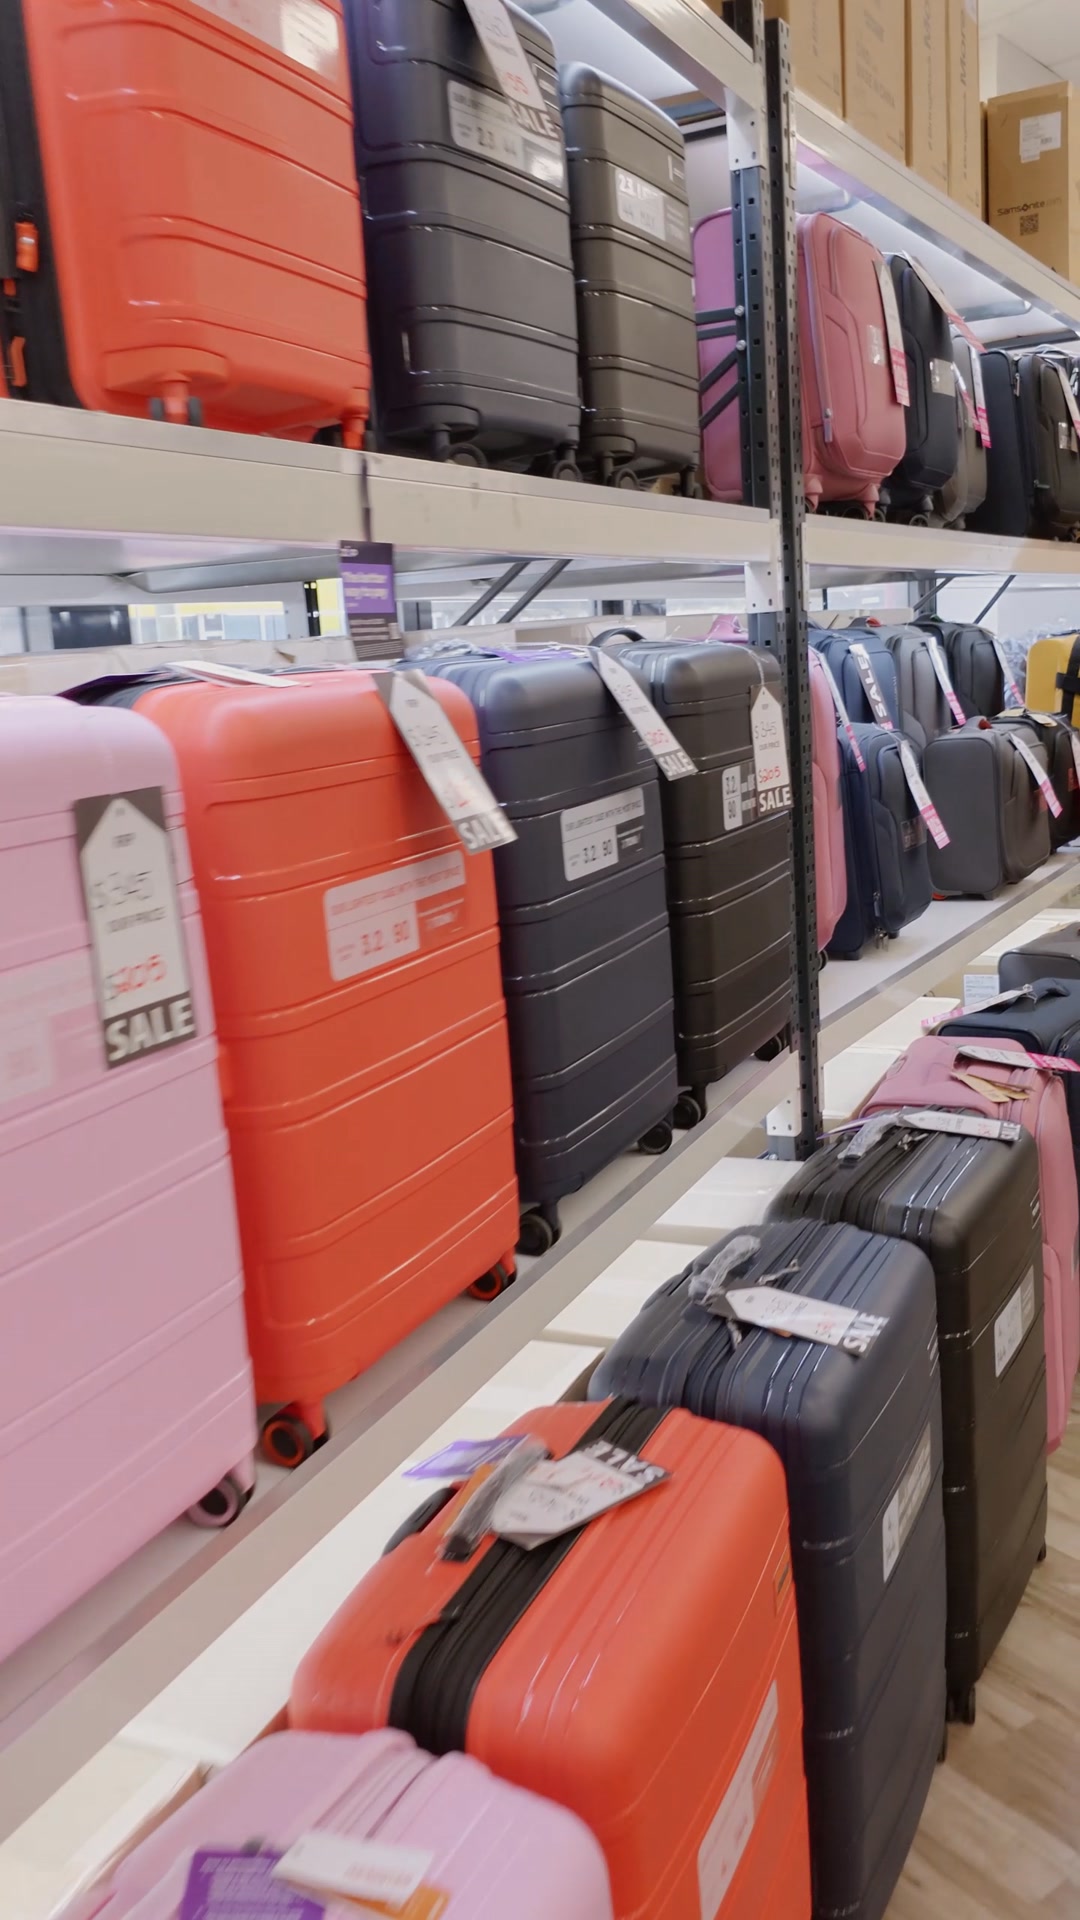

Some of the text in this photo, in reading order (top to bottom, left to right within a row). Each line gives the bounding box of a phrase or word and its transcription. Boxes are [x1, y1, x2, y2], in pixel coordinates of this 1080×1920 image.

[857, 654, 888, 718] SALE
[659, 750, 695, 777] SALE
[759, 787, 792, 812] SALE
[458, 811, 515, 850] SALE
[105, 997, 196, 1062] SALE
